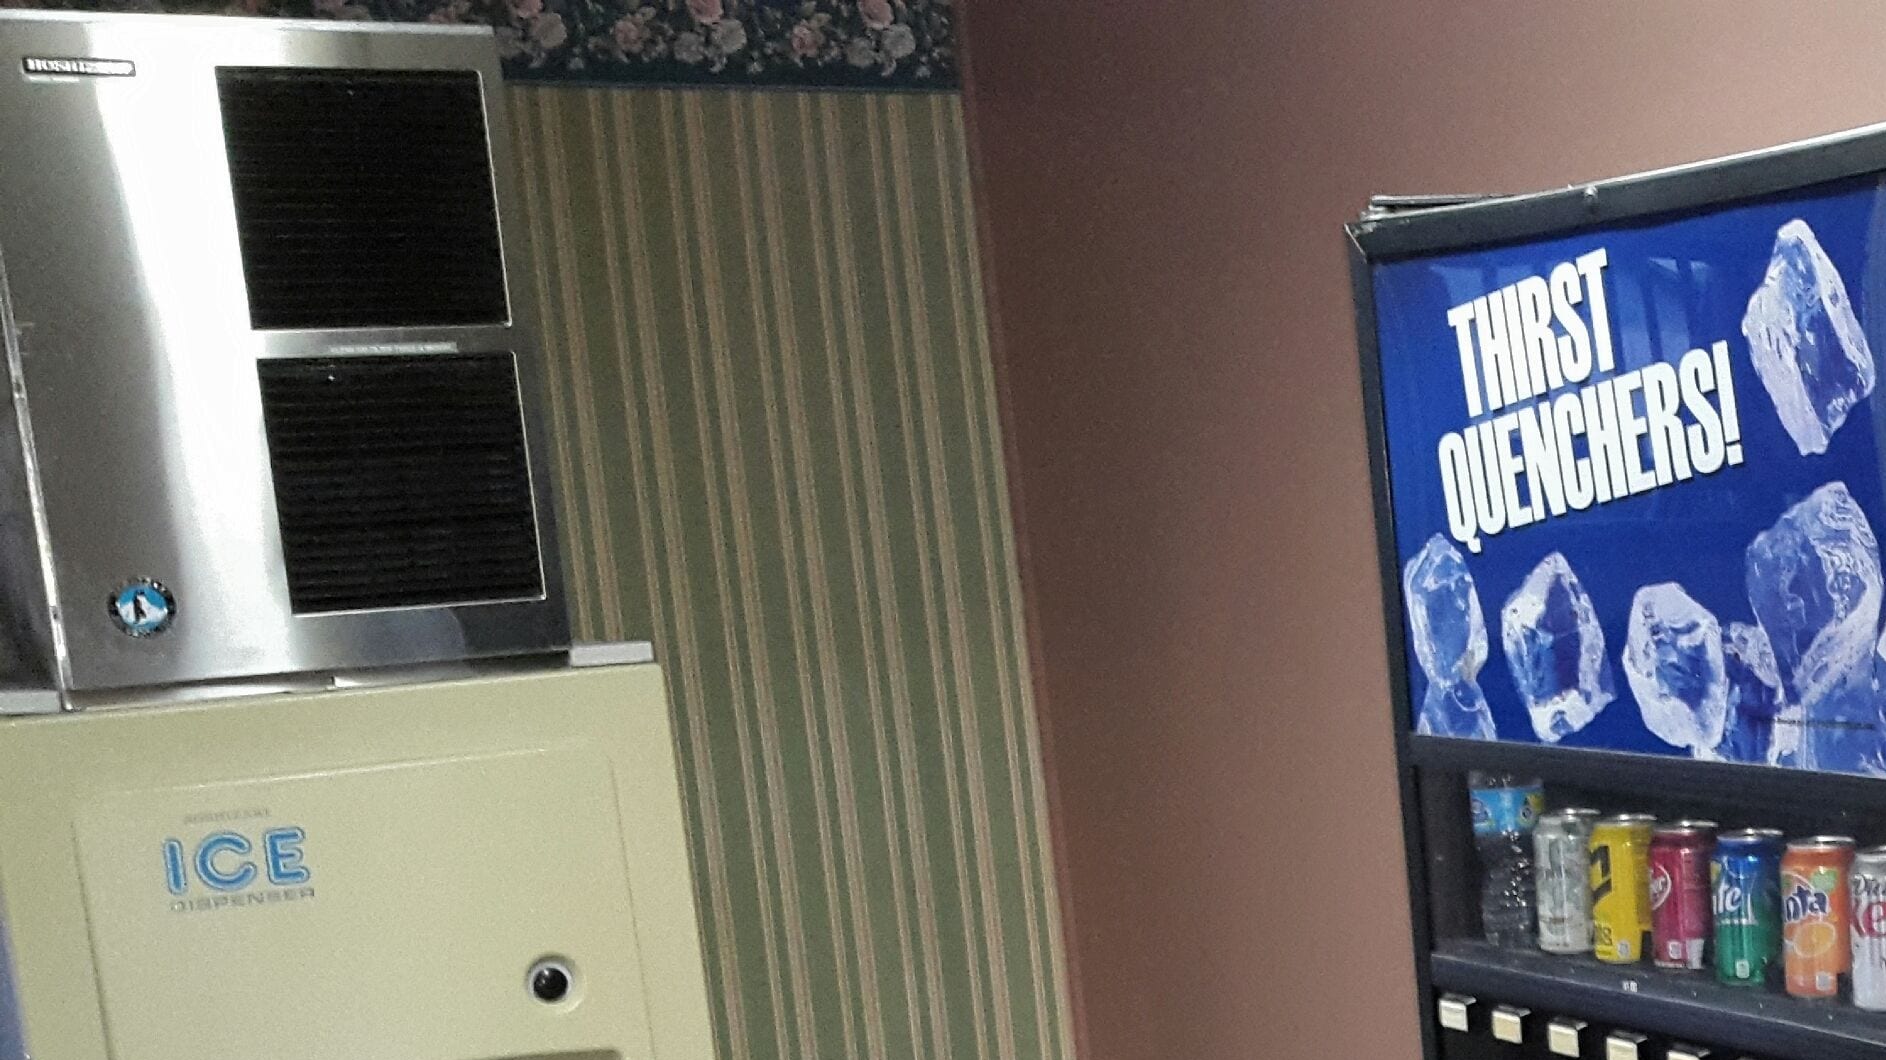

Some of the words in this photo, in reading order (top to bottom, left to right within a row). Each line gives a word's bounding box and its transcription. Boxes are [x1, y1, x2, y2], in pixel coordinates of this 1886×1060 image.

[1447, 247, 1615, 417] THIRST
[1438, 339, 1743, 553] QUENCHERS!
[163, 827, 310, 894] ICE
[170, 887, 315, 912] DISPENSER
